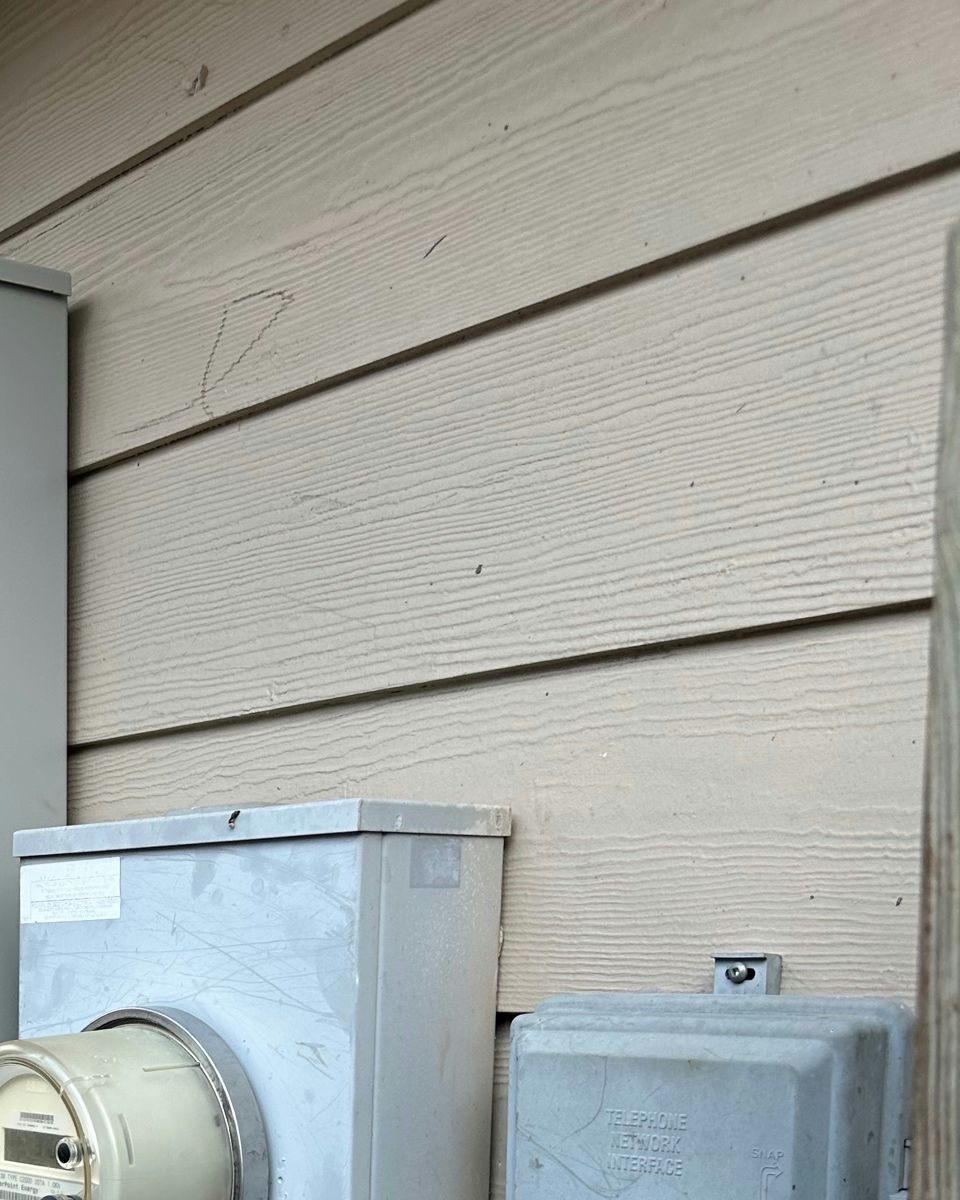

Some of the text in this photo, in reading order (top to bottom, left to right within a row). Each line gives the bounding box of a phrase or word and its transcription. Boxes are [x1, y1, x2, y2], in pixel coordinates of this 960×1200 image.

[605, 1108, 687, 1131] TELEPHONE
[610, 1131, 680, 1153] NETWORK
[751, 1148, 784, 1160] SNAP
[607, 1152, 683, 1177] INTERFACE
[7, 1173, 17, 1181] TYPE
[20, 1184, 38, 1194] Energy
